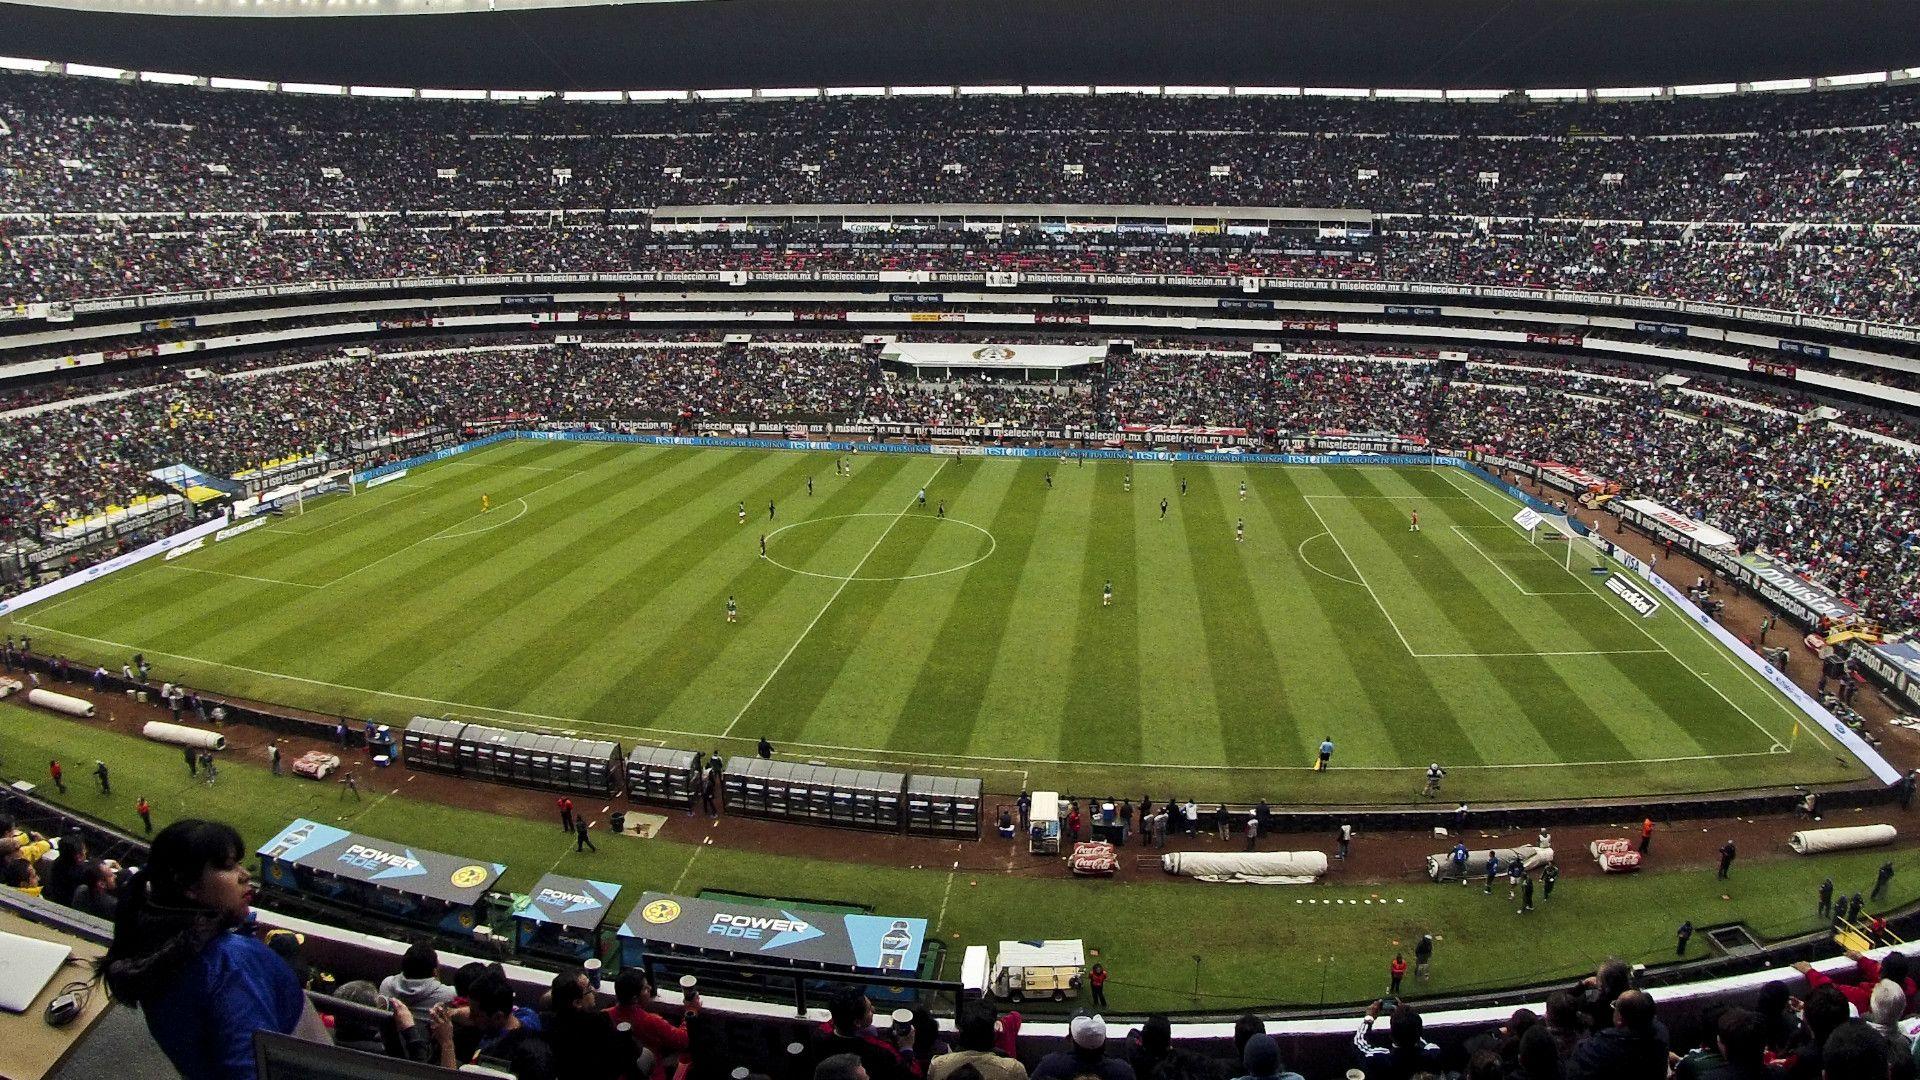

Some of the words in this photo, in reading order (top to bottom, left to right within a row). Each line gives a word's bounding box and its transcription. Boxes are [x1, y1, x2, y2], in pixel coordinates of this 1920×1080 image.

[467, 274, 524, 285] miseleccion.mx
[534, 273, 590, 283] miseleccion.mx
[599, 272, 654, 281] miseleccion.mx
[664, 271, 719, 281] miseleccion.mx
[755, 271, 811, 281] miseleccion.mx
[822, 271, 879, 281] miseleccion.mx
[1027, 273, 1087, 283] miseleccion.mx
[1097, 274, 1157, 285] miseleccion.mx
[1167, 276, 1227, 287] miseleccion.mx
[401, 277, 457, 287] miseleccion.mx
[1268, 279, 1329, 290] miseleccion.mx
[1339, 281, 1401, 292] miseleccion.mx
[1411, 284, 1472, 296] miseleccion.mx
[1483, 287, 1544, 300] miseleccion.mx
[1554, 292, 1613, 304] miseleccion.mx
[1387, 306, 1409, 314] Corona
[1413, 307, 1434, 315] Corona
[1637, 323, 1656, 332] Corona
[1660, 325, 1680, 334] Corona
[790, 441, 832, 450] restonic
[1317, 438, 1388, 452] miseleccion.mx
[984, 447, 1030, 457] restonic
[1288, 455, 1333, 464] restonic
[1623, 552, 1640, 572] VISA
[1756, 567, 1846, 618] movistar
[1620, 589, 1651, 614] adidas
[337, 853, 378, 871] ADE
[345, 844, 420, 870] POWER
[535, 894, 566, 907] ADE
[540, 888, 595, 905] POWER
[711, 912, 809, 933] POWER
[707, 924, 763, 939] ADE
